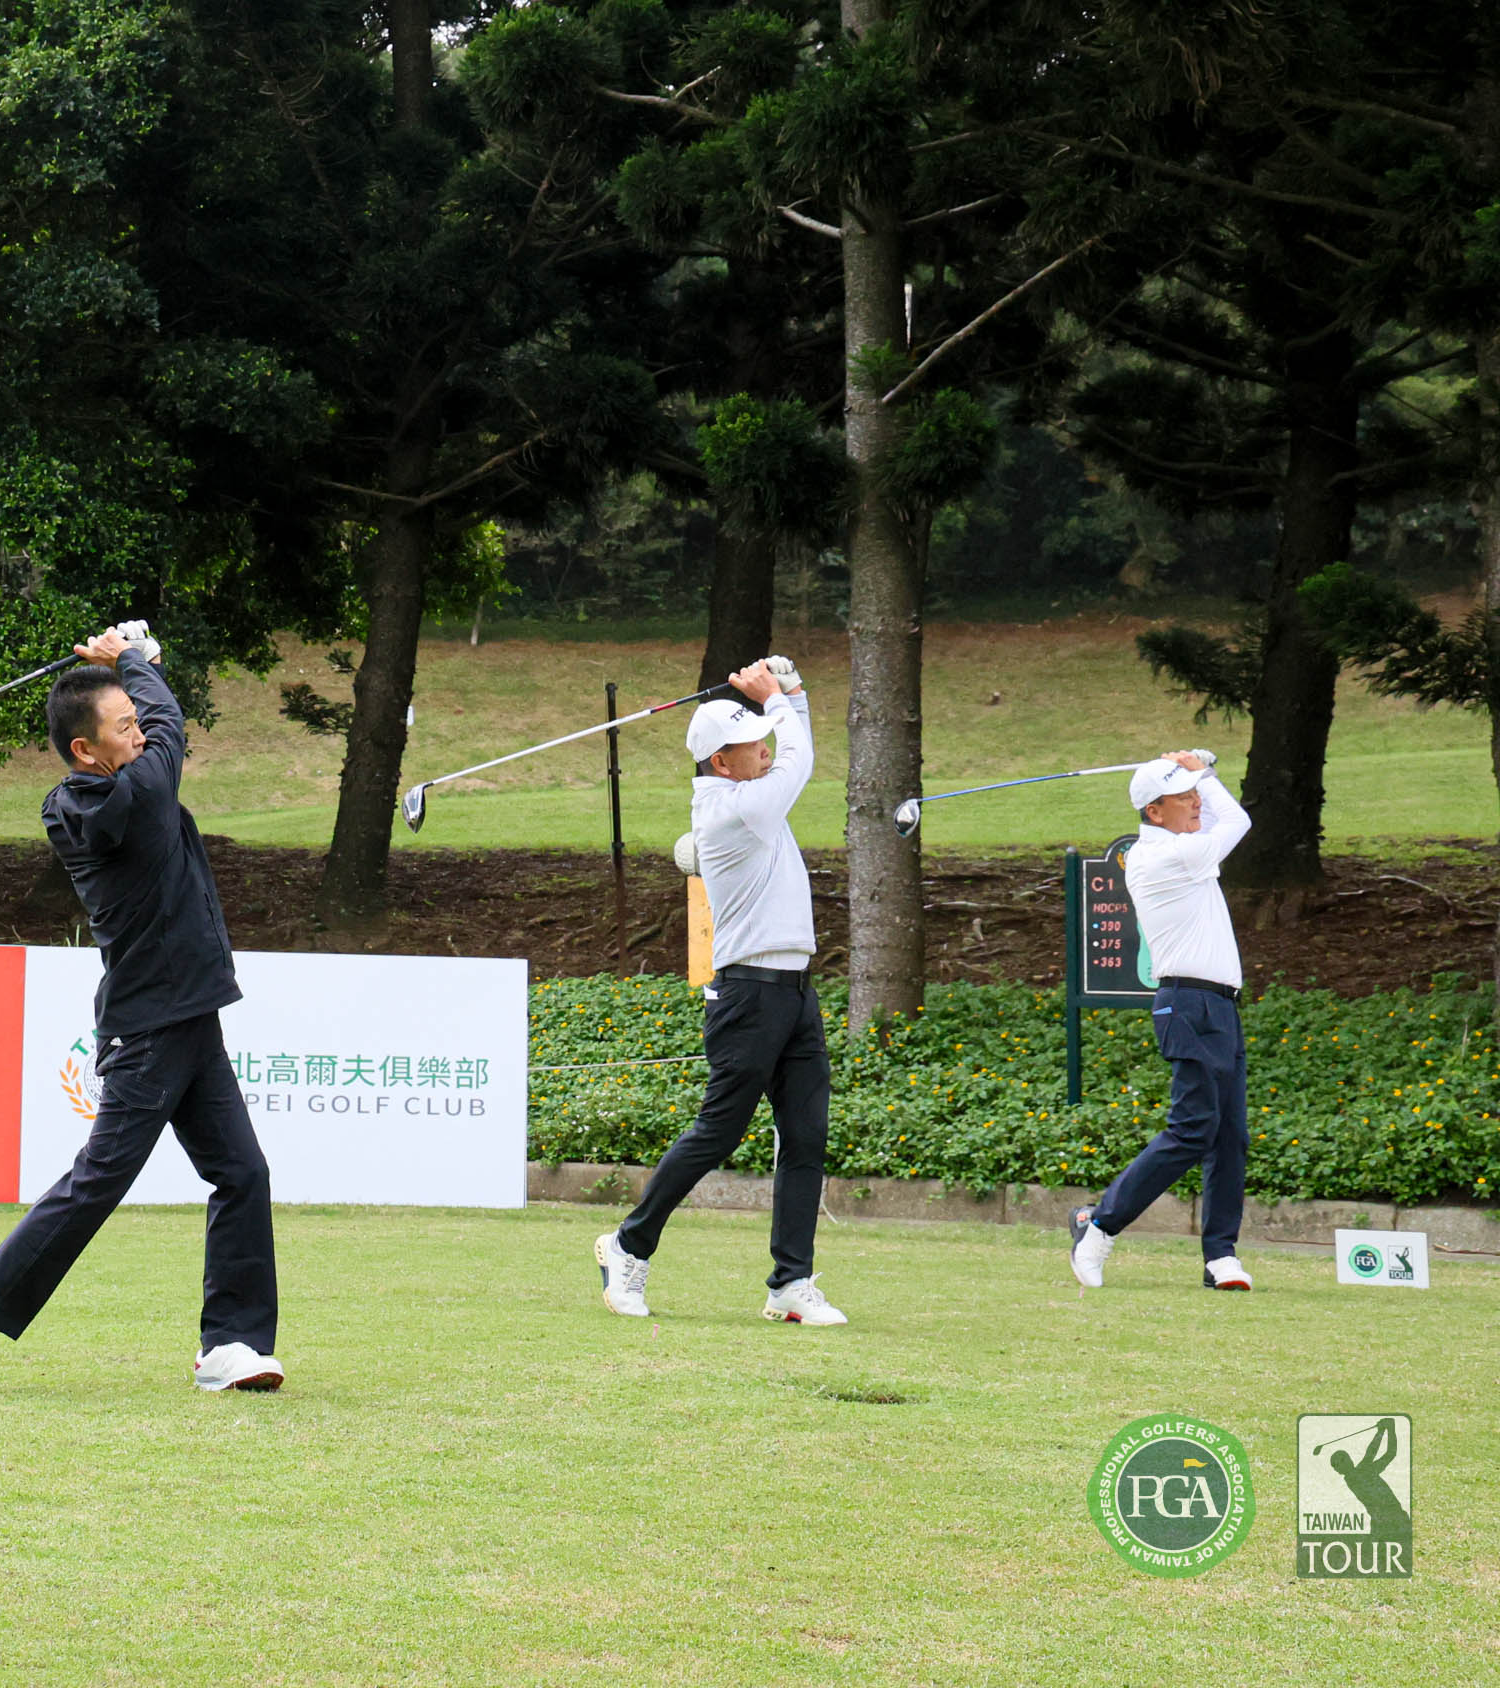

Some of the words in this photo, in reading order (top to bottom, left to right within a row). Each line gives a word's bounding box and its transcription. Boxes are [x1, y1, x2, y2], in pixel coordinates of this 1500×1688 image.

[1100, 920, 1121, 931] 390
[1100, 938, 1121, 949] 375
[1100, 956, 1122, 967] 363
[230, 1051, 489, 1089] 北高爾夫俱樂部
[244, 1093, 292, 1111] PEI
[307, 1094, 390, 1114] GOLF
[404, 1097, 486, 1116] CLUB
